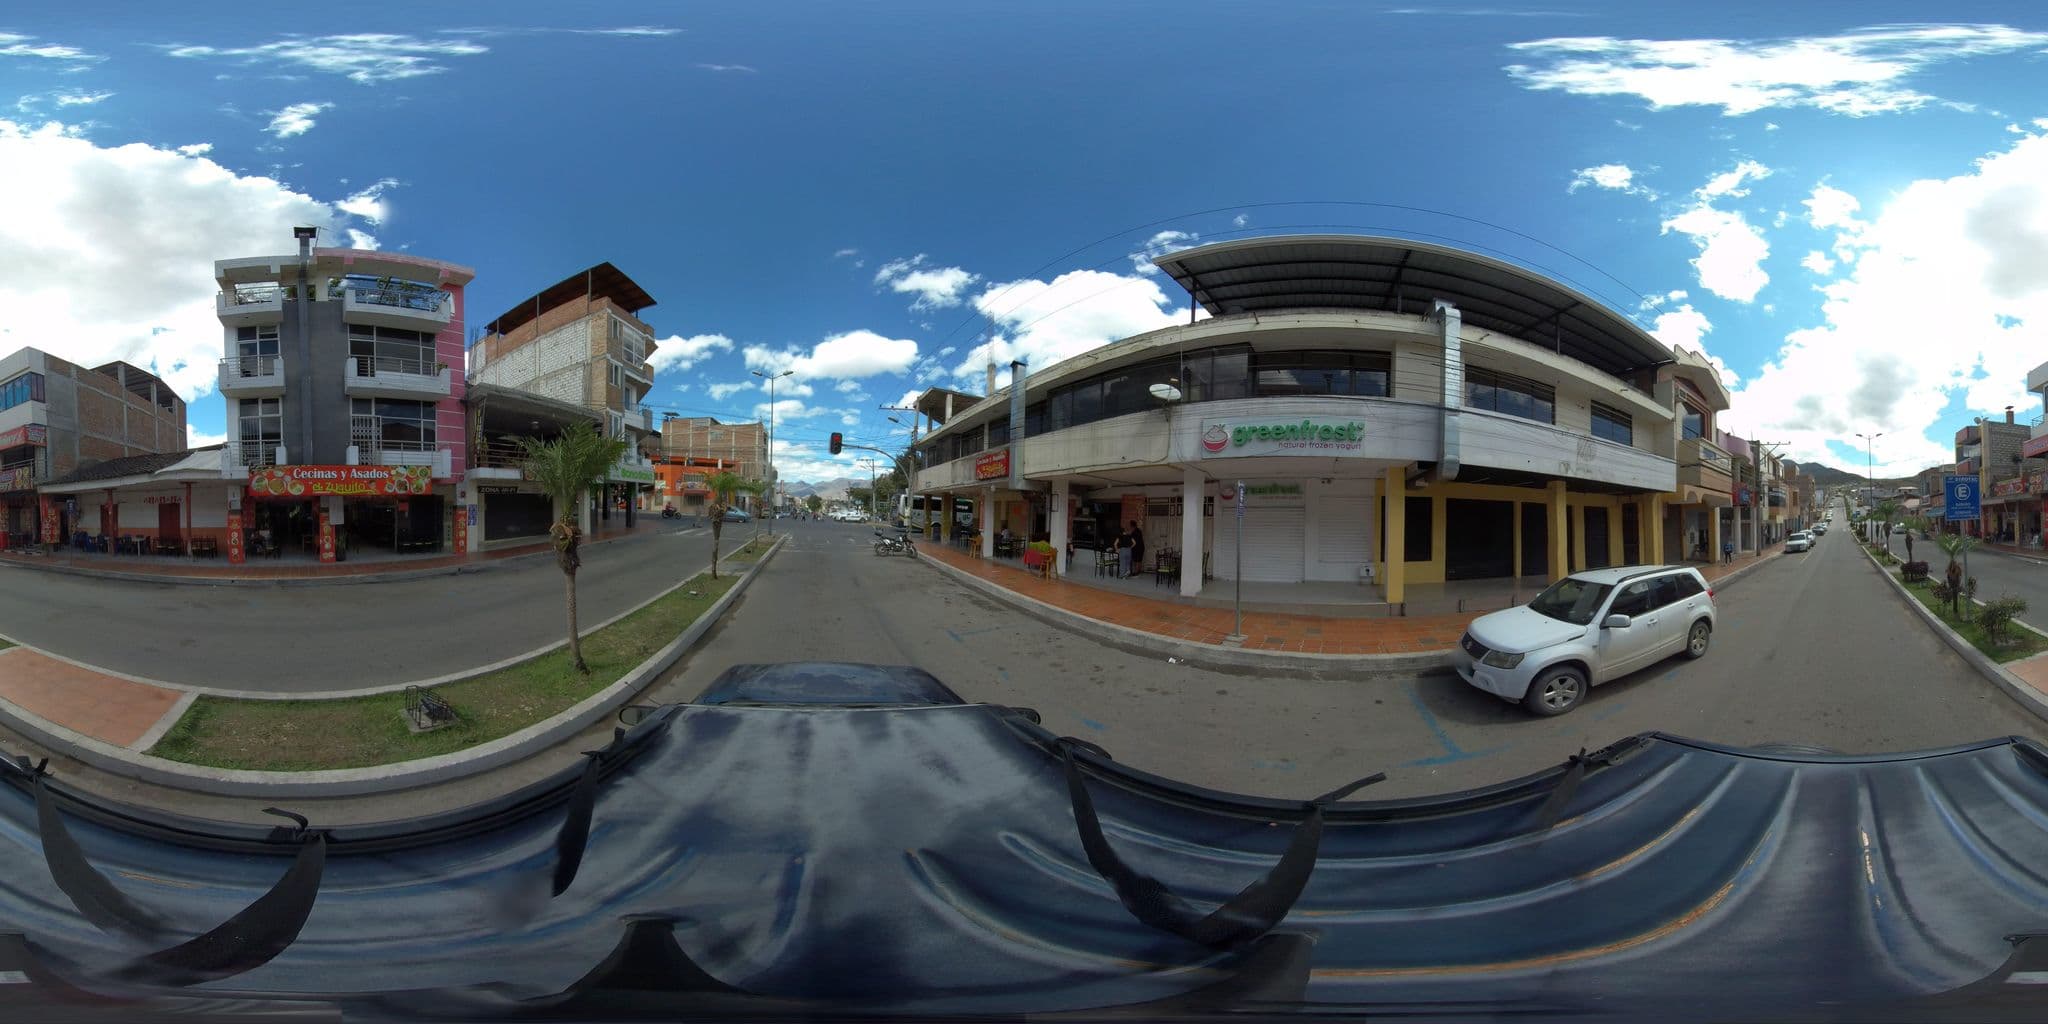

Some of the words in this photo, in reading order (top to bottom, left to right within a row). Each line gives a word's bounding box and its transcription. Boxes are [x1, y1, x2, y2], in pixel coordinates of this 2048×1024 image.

[1232, 419, 1358, 447] greenfrost
[1278, 441, 1307, 449] natural
[1309, 441, 1334, 449] frozen
[293, 468, 337, 479] Cecinas
[341, 470, 348, 481] y
[351, 468, 389, 479] Asados
[1957, 486, 1968, 498] E
